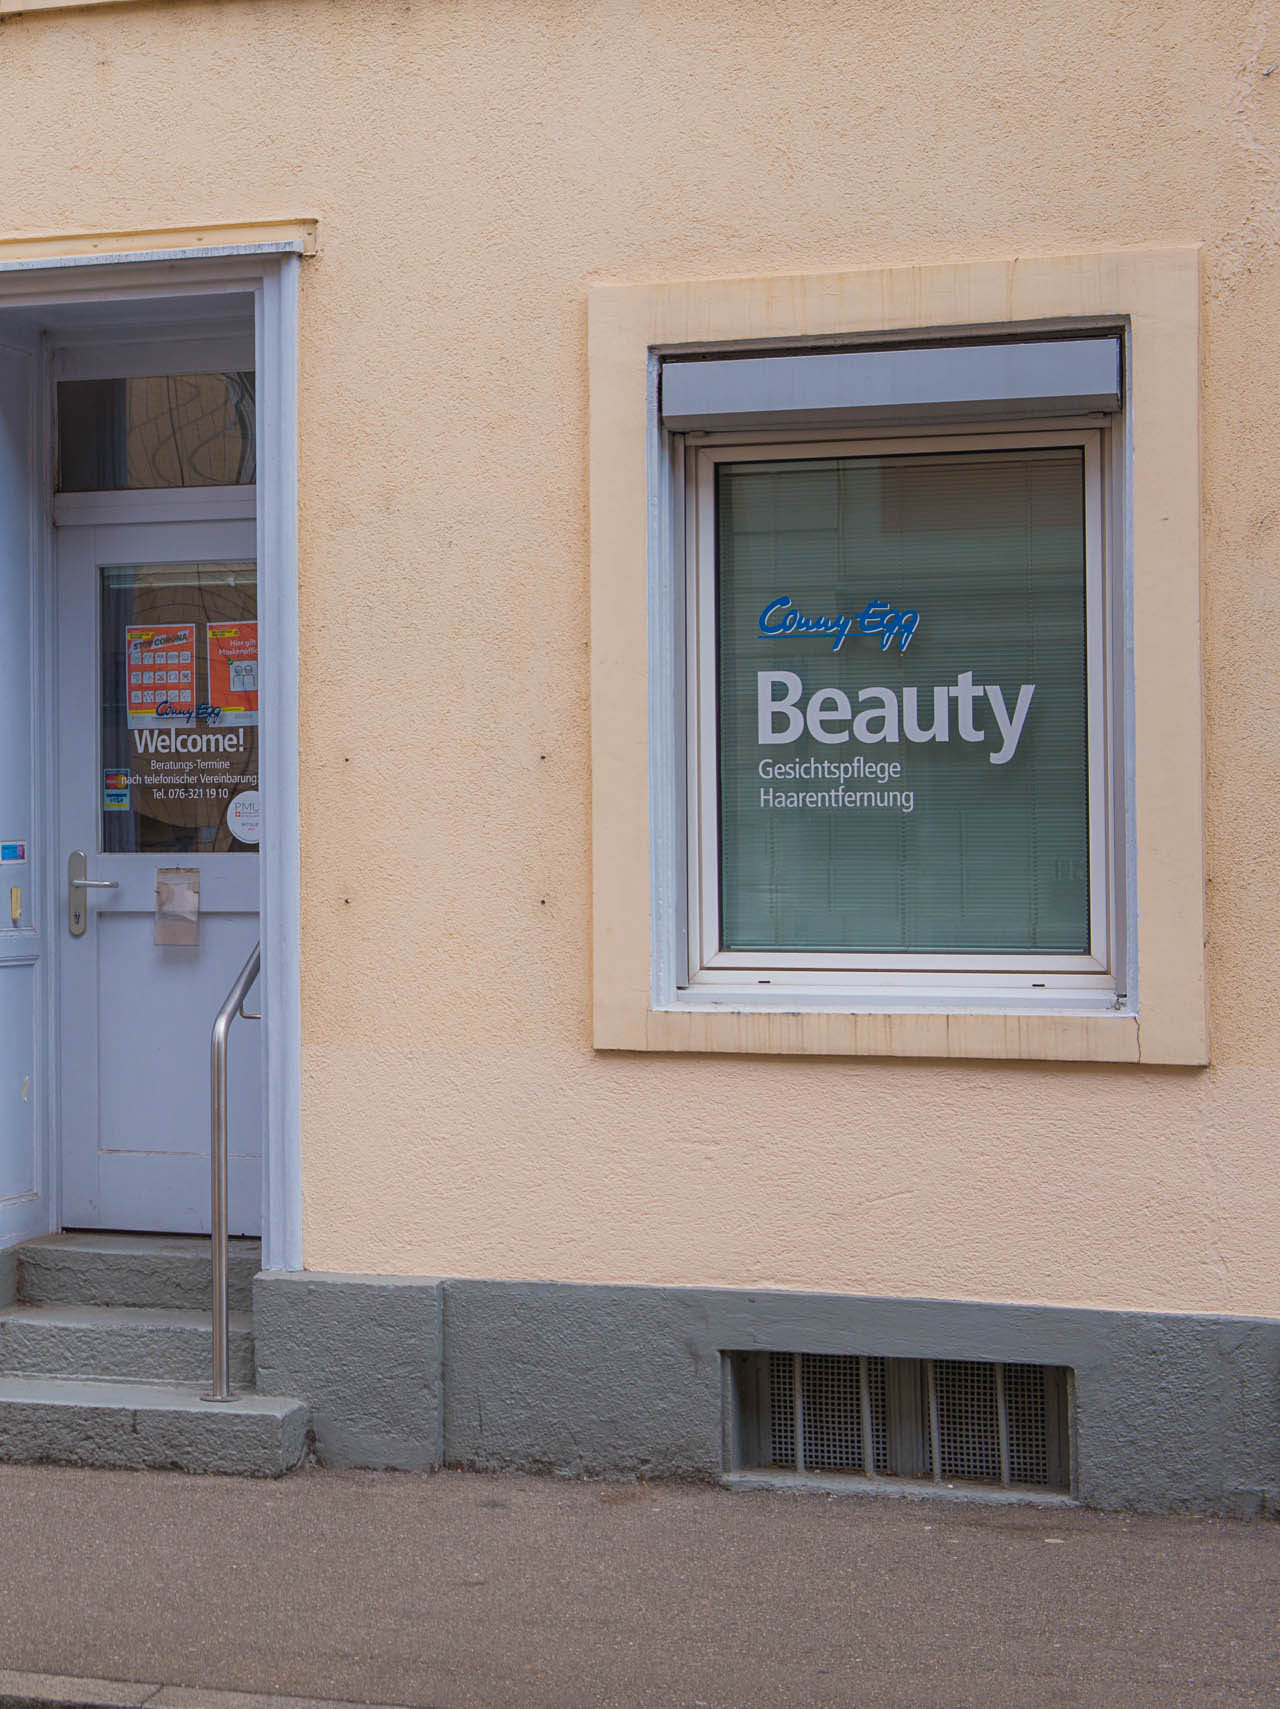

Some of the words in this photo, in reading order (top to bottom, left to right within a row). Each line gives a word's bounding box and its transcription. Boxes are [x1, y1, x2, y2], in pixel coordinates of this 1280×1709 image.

[757, 596, 852, 651] Conny
[856, 599, 919, 653] Egg
[154, 700, 193, 724] Conny
[195, 701, 222, 724] Egg
[757, 671, 1036, 765] Beauty
[134, 728, 244, 753] Welcome!
[151, 760, 230, 772] Beratungs-Termine
[758, 757, 901, 783] Gesichtspflege
[121, 774, 142, 784] nach
[144, 774, 197, 784] telefonischer
[200, 774, 257, 786] Vereinbarung
[153, 789, 166, 799] Tel.
[168, 789, 203, 799] 076-321
[206, 789, 217, 799] 19
[218, 788, 229, 798] 10
[760, 786, 914, 812] Haarentfernung
